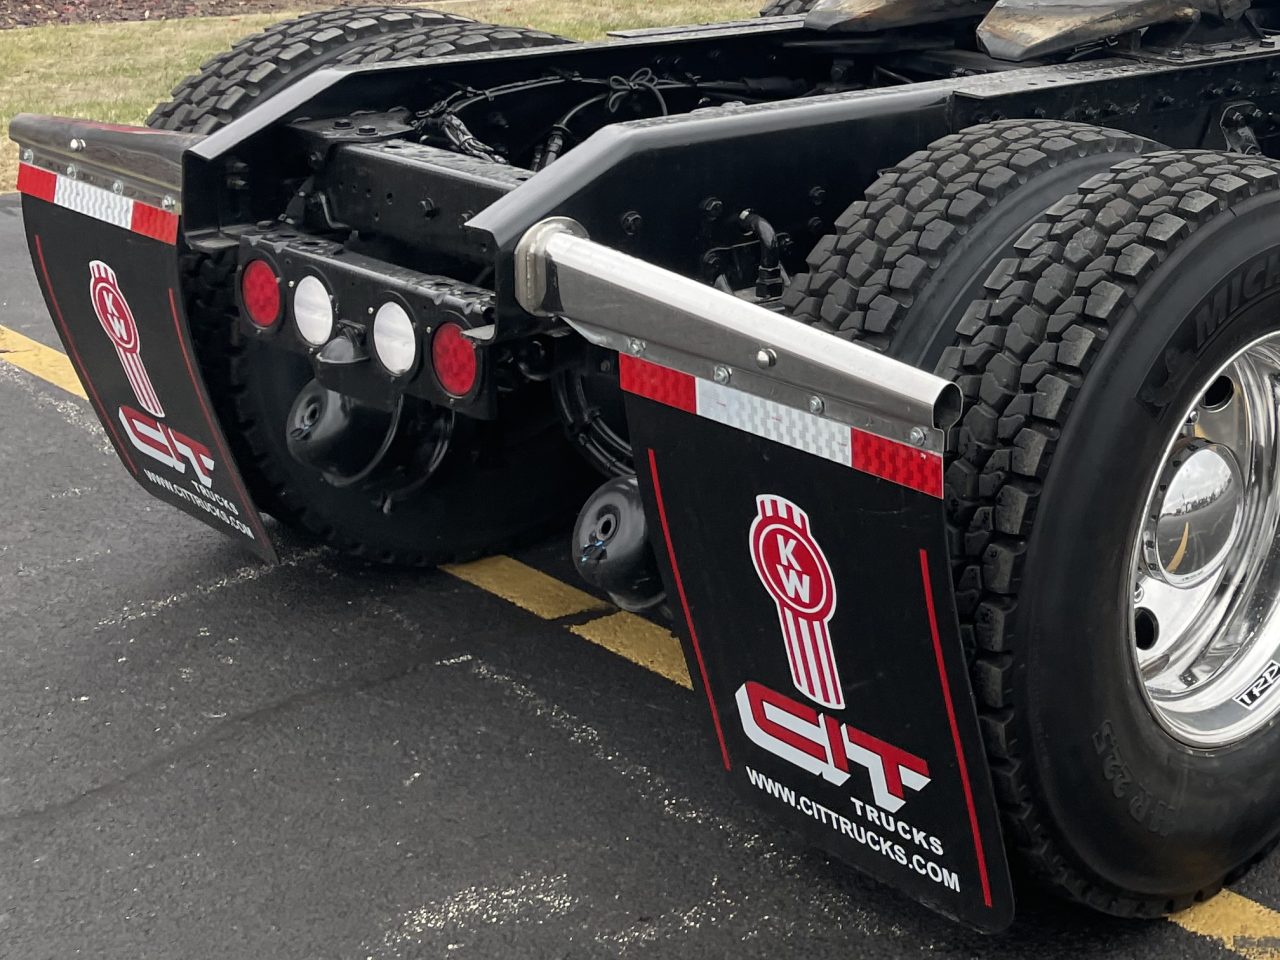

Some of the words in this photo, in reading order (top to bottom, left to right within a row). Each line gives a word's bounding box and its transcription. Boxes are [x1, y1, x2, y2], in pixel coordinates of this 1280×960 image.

[191, 480, 239, 516] TRUCKS
[735, 680, 932, 814] CIT
[745, 765, 961, 894] WWW.CITTRUCKS.COM
[849, 796, 945, 857] TRUCKS
